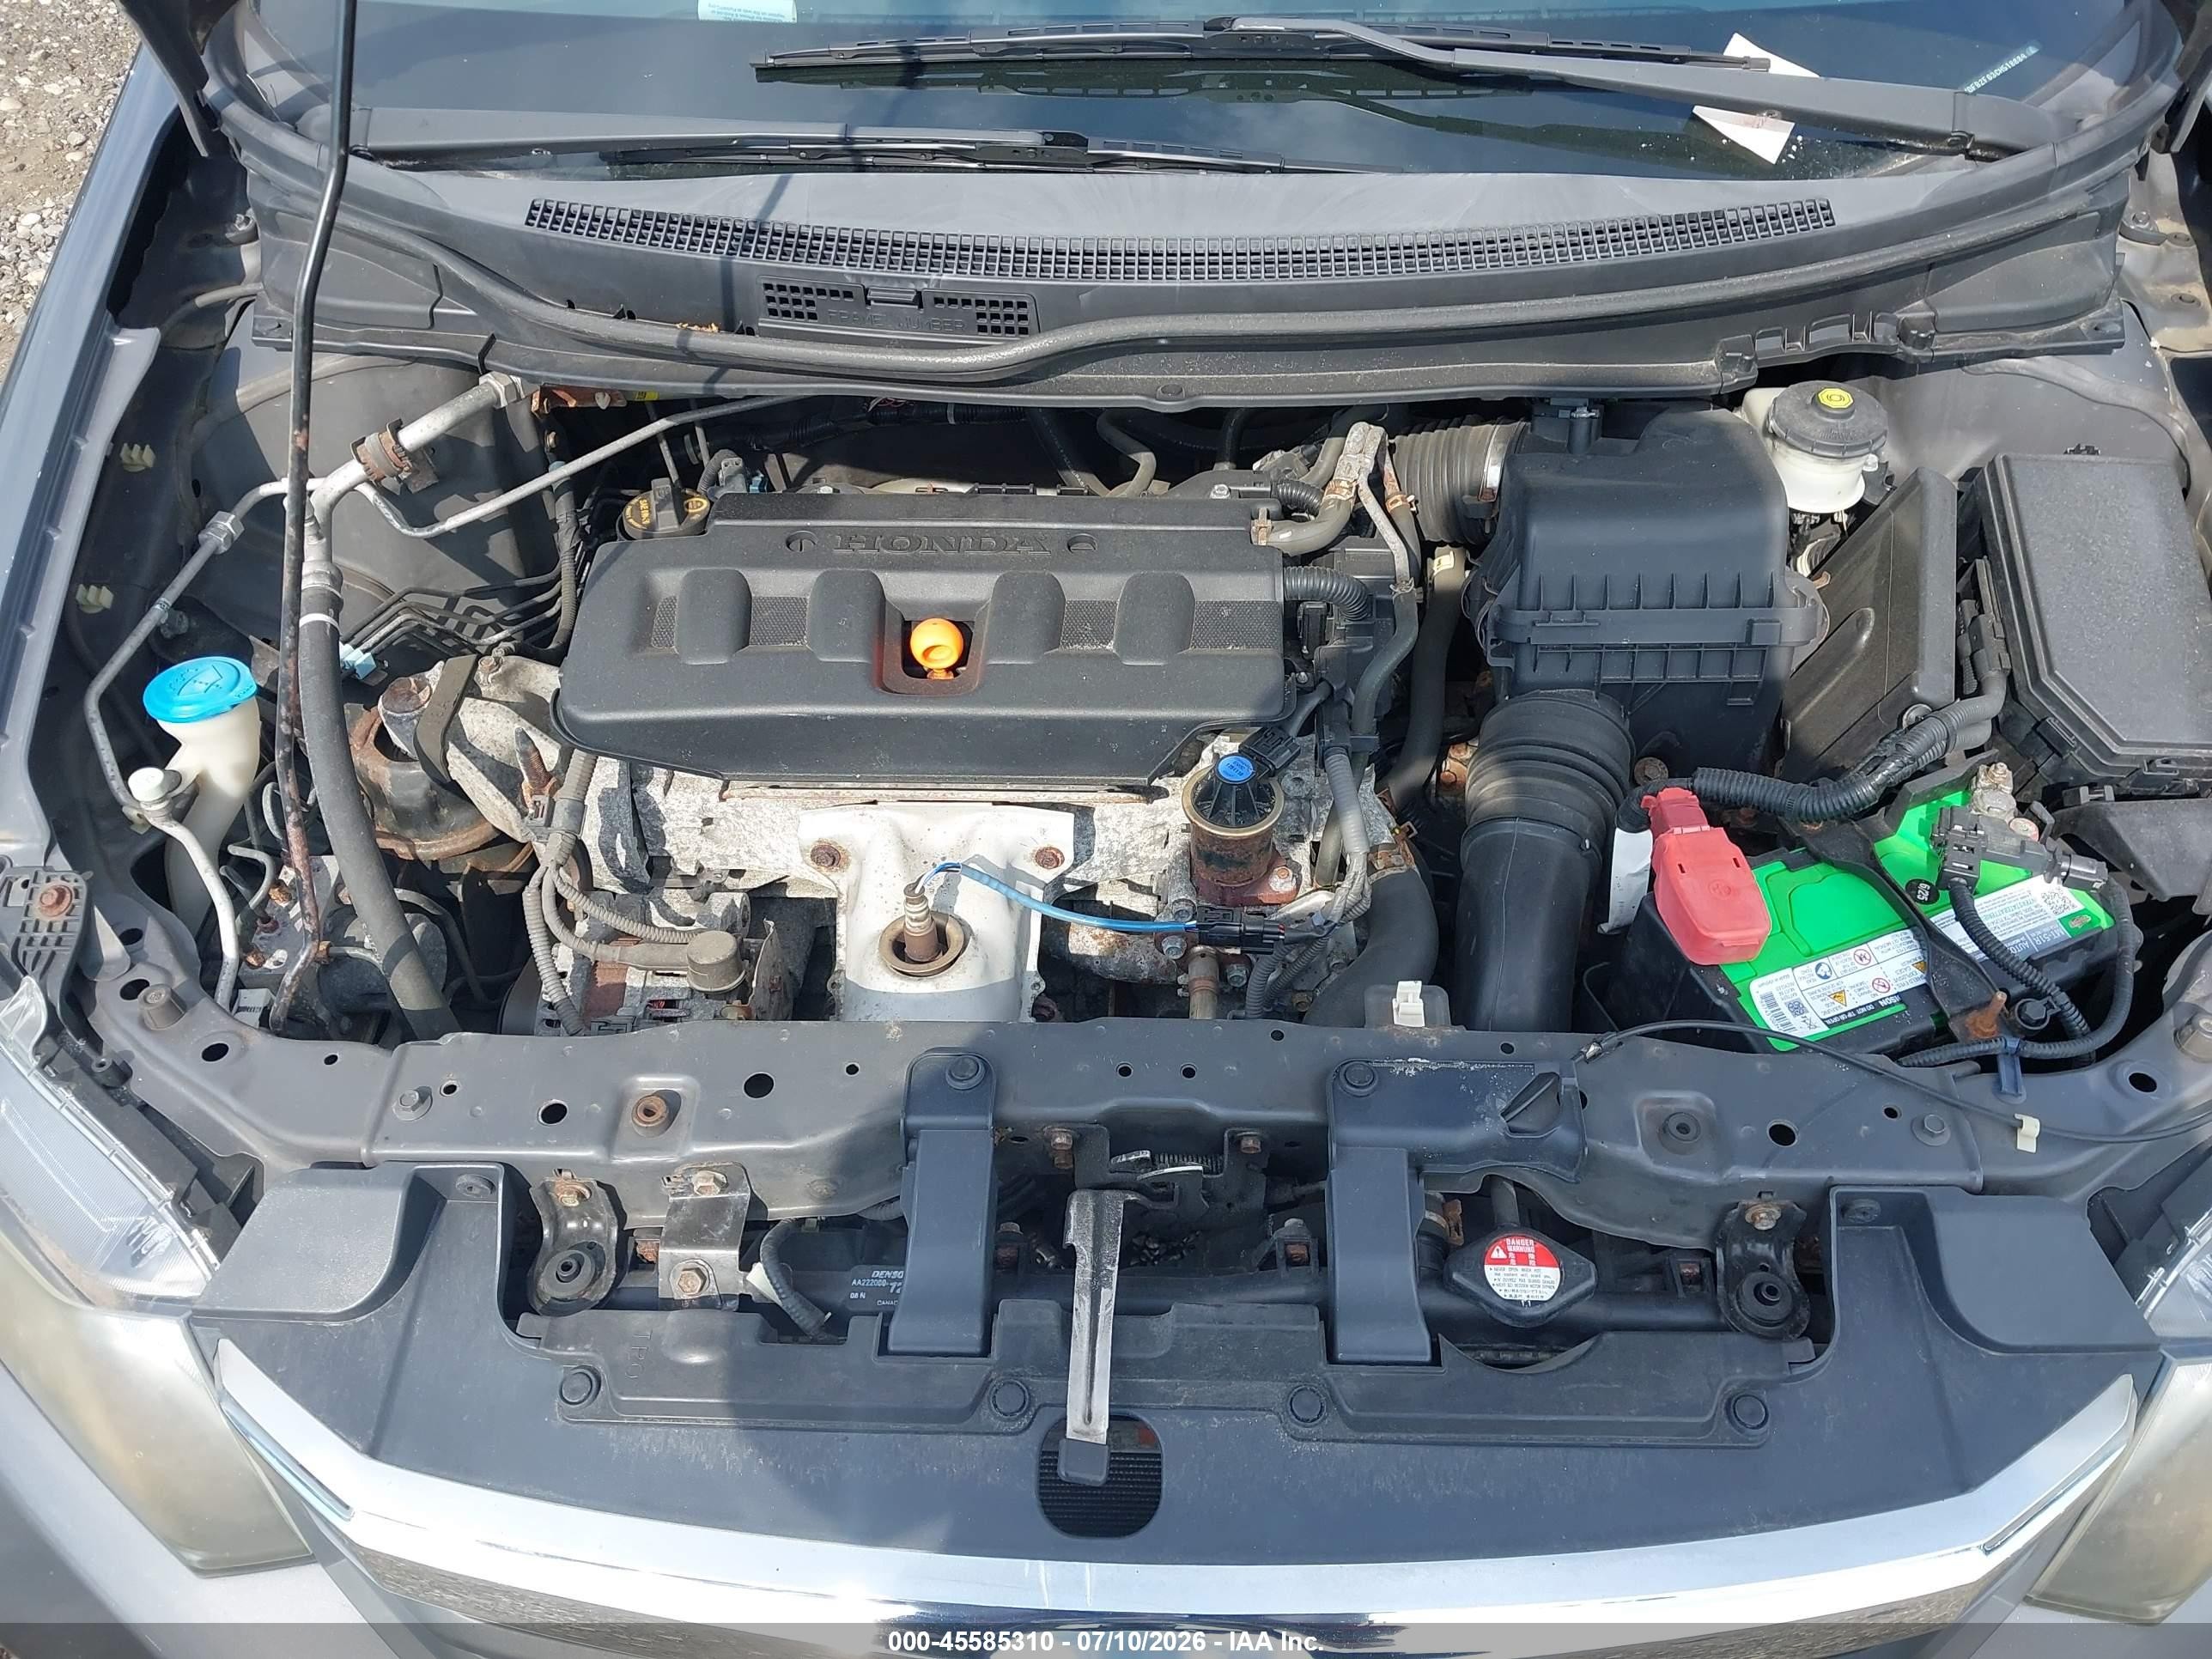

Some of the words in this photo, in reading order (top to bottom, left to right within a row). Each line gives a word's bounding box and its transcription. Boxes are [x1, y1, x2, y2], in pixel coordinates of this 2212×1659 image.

[828, 309, 886, 326] FRAME
[833, 534, 1051, 556] HONDA
[1917, 883, 1931, 901] 6/25
[2032, 927, 2064, 945] MT-51R
[2005, 939, 2032, 956] AUTO
[871, 1270, 904, 1279] DENSO
